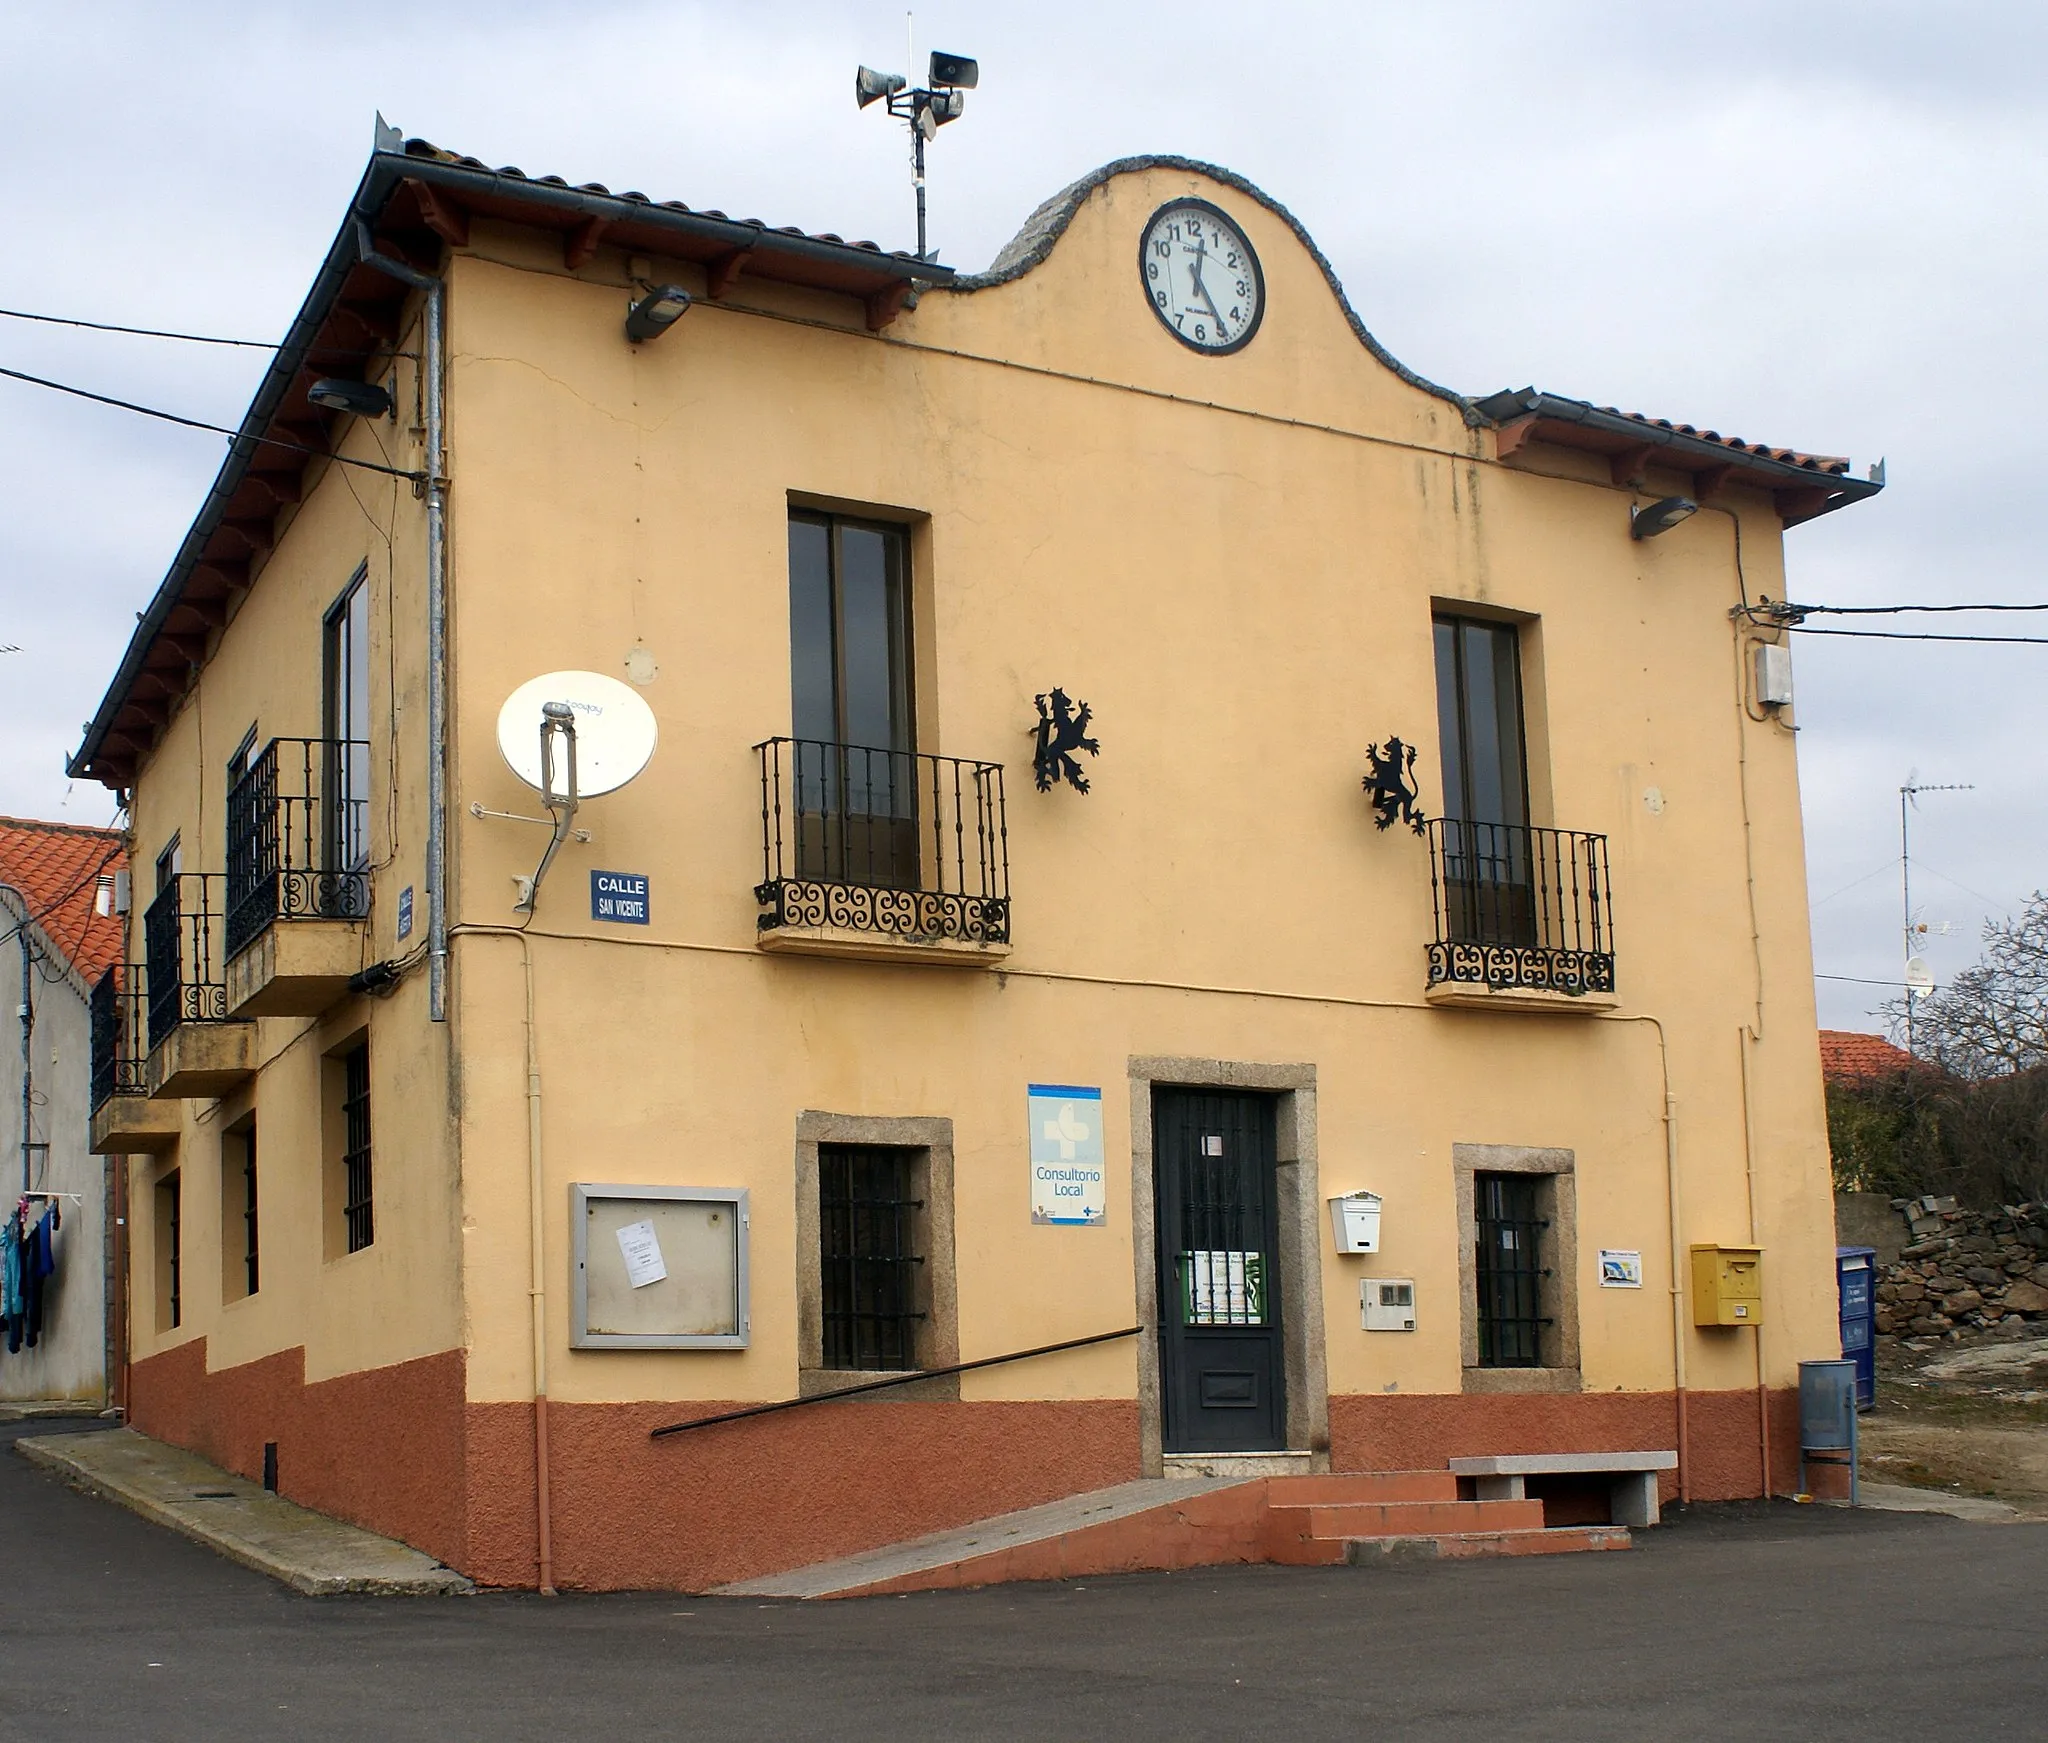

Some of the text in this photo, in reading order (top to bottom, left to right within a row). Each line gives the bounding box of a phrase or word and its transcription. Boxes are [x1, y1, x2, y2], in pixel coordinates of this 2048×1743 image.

[1166, 223, 1181, 242] 11
[1185, 219, 1202, 237] 12
[1153, 239, 1171, 258] 10
[1211, 232, 1219, 248] 1
[1227, 252, 1237, 269] 2
[1148, 263, 1159, 280] 9
[1236, 280, 1246, 297] 3
[1156, 291, 1168, 308] 8
[1174, 313, 1184, 329] 7
[1229, 306, 1241, 322] 4
[1195, 324, 1206, 340] 6
[598, 877, 645, 895] CALLE
[599, 897, 644, 918] SAN VICENTE
[1036, 1166, 1101, 1182] Consultorio
[1054, 1183, 1084, 1197] Local
